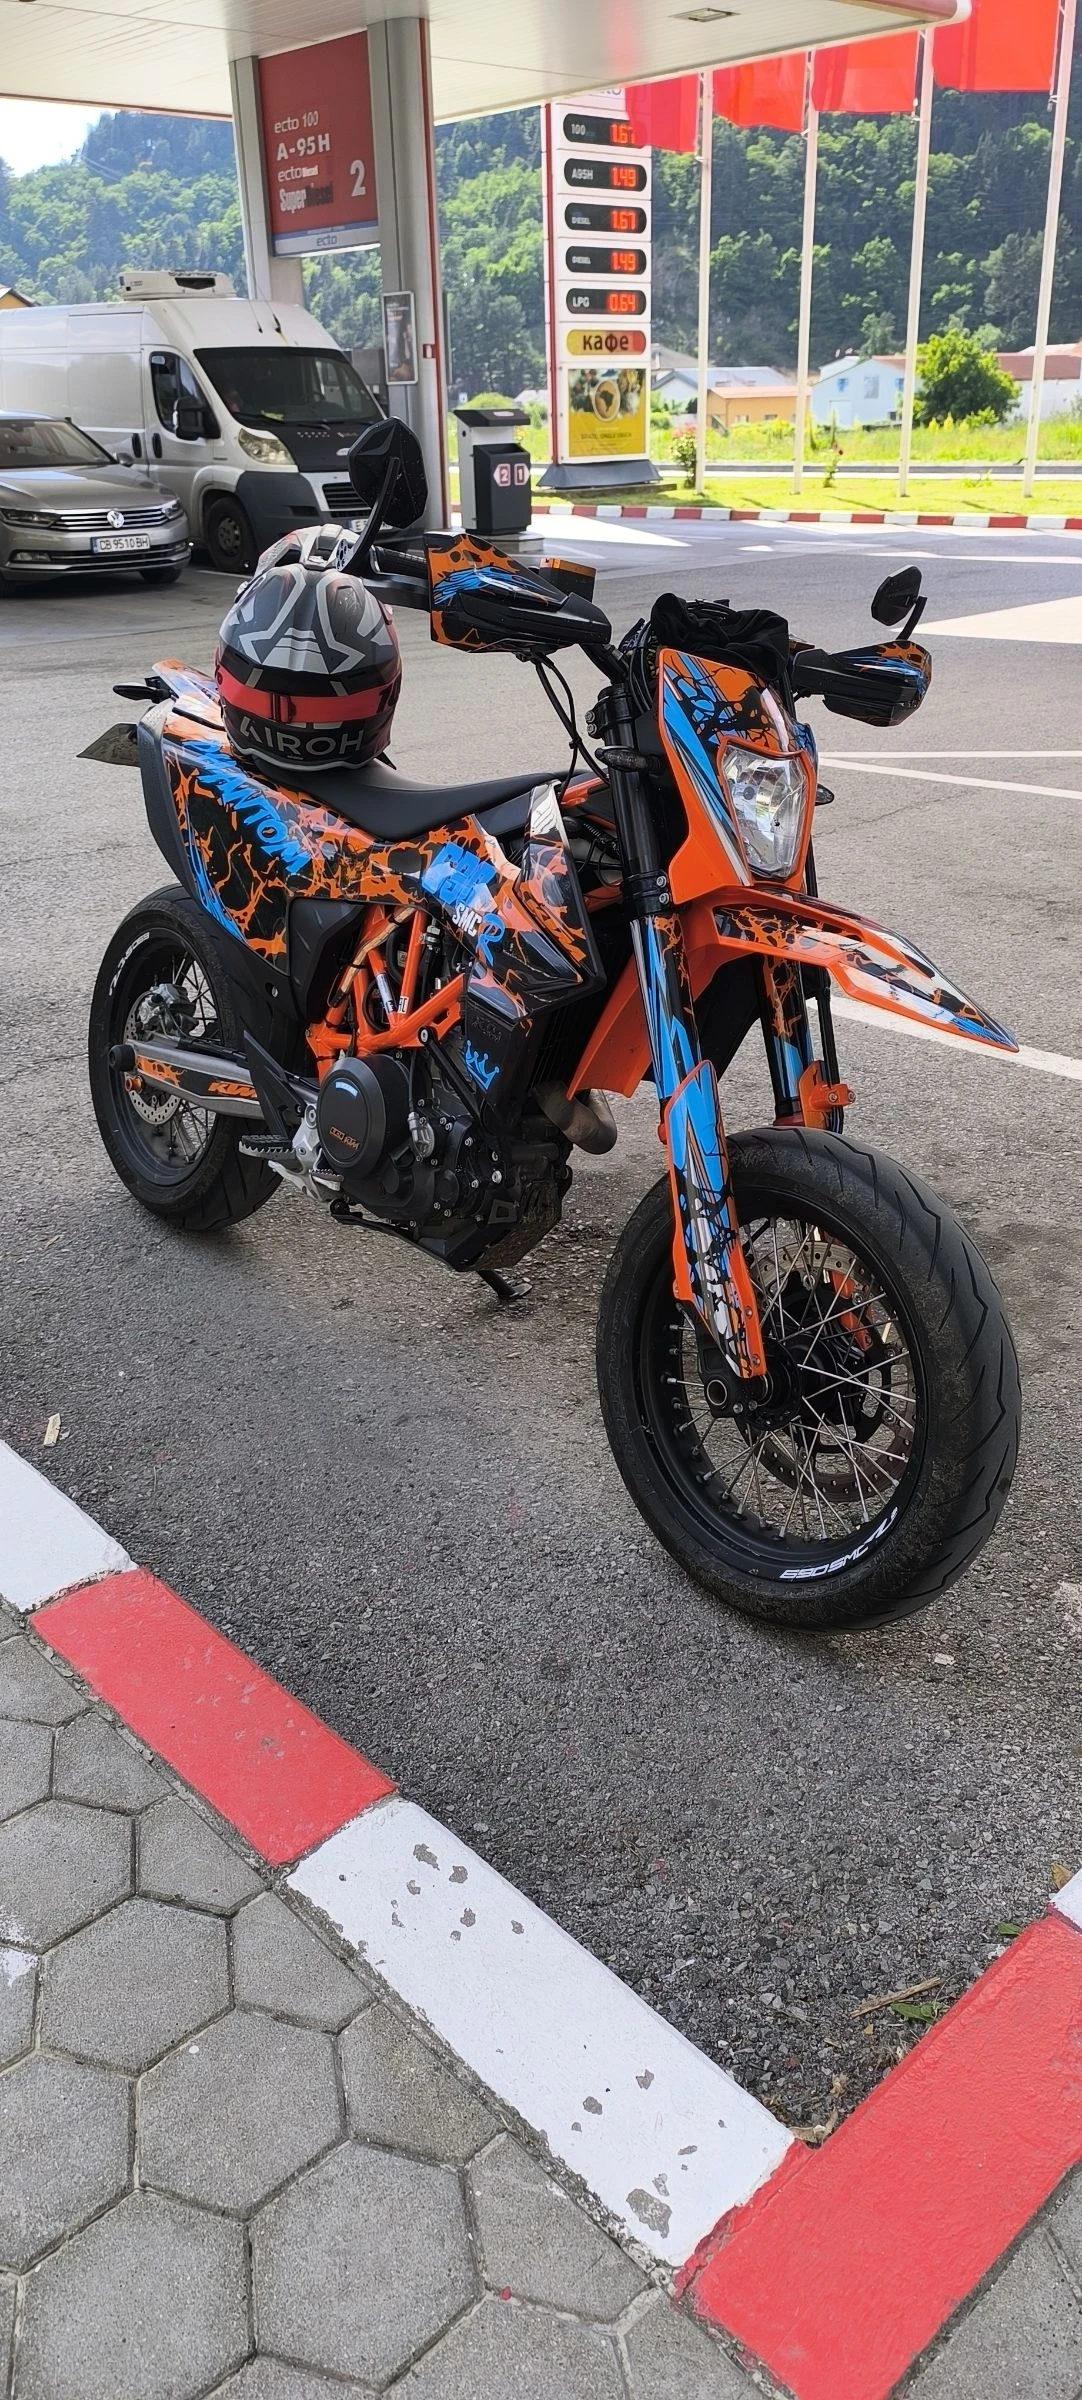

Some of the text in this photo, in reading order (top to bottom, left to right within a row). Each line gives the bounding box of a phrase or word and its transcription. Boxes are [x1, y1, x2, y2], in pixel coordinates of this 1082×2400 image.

[274, 110, 319, 134] ecto 100
[571, 123, 586, 136] 100
[350, 159, 367, 197] 2
[316, 234, 338, 246] ecto
[572, 296, 590, 308] LPG
[500, 468, 523, 482] 2 1
[239, 715, 365, 757] AIROH
[451, 902, 484, 938] SMC
